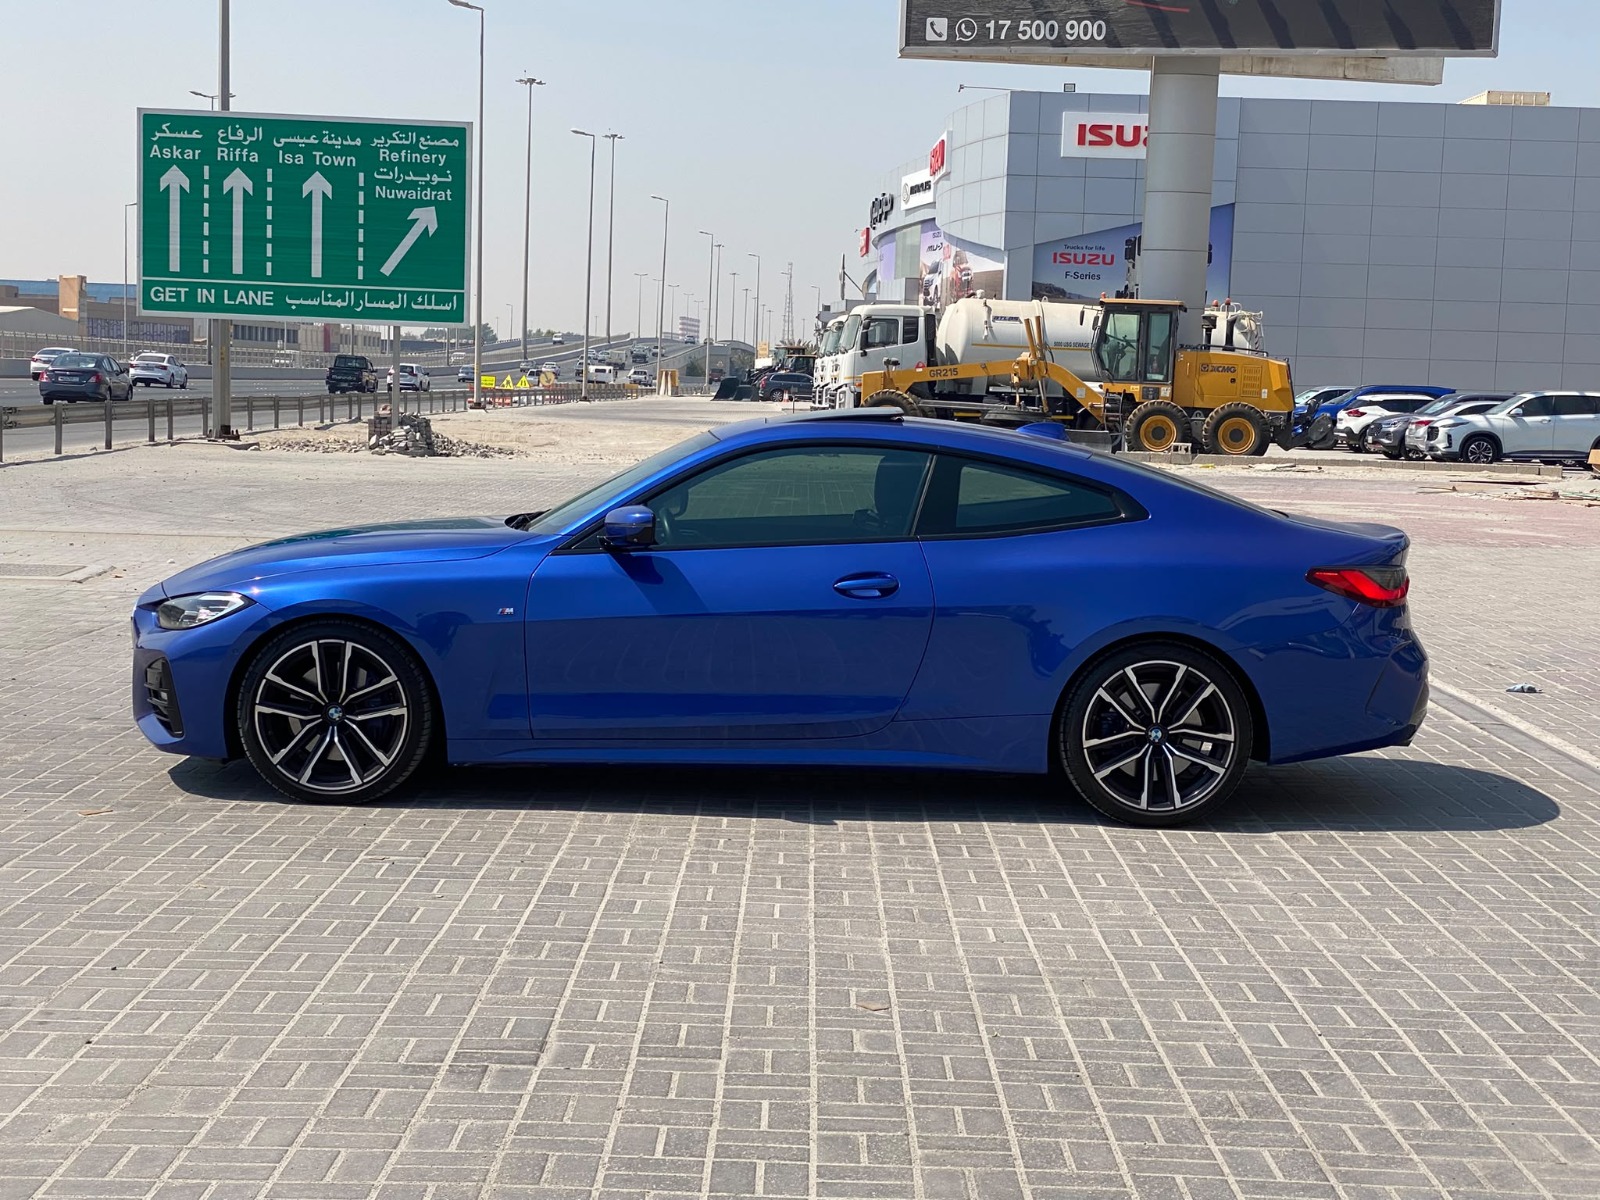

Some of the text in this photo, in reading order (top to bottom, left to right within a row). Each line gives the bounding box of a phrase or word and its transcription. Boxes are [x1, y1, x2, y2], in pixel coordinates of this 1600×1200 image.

[985, 20, 1106, 40] 17 500 900
[151, 122, 203, 141] عسكر
[217, 124, 263, 145] الرفاع
[273, 130, 362, 149] مدينة عيسى
[370, 131, 459, 150] مصنع التكرير
[1077, 123, 1148, 147] ISU
[149, 144, 202, 160] Askar
[217, 147, 259, 163] Riffa
[279, 149, 356, 167] Isa Town
[379, 148, 447, 167] Refinery
[373, 165, 453, 185] نويدرات
[375, 185, 452, 201] Nuwaidrat
[1052, 252, 1116, 266] ISUZU
[1064, 270, 1101, 281] F-Series
[150, 286, 274, 306] GET IN LANE
[285, 289, 457, 312] اسلك المسار المناسب
[928, 368, 959, 378] GR215
